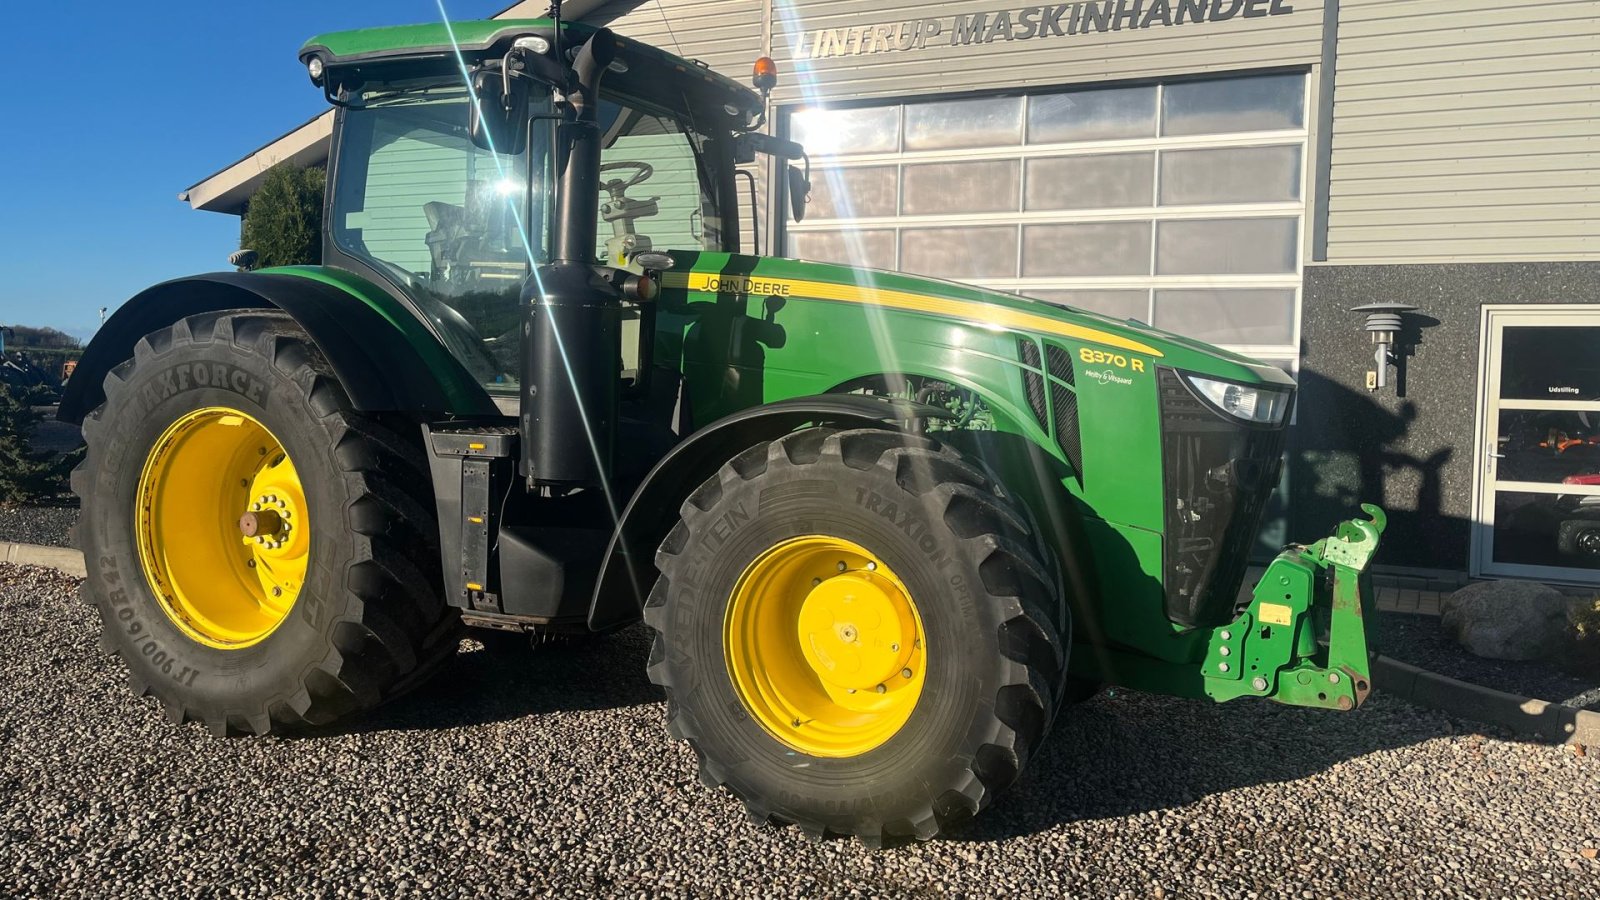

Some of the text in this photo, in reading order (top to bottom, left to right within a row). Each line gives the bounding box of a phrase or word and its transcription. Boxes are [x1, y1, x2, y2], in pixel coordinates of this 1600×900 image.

[794, 18, 942, 58] LINTRUP
[701, 276, 790, 295] JOHN DEERE
[1080, 348, 1144, 373] 8370 R
[1548, 386, 1580, 394] Udstilling
[855, 486, 952, 570] TRAXION
